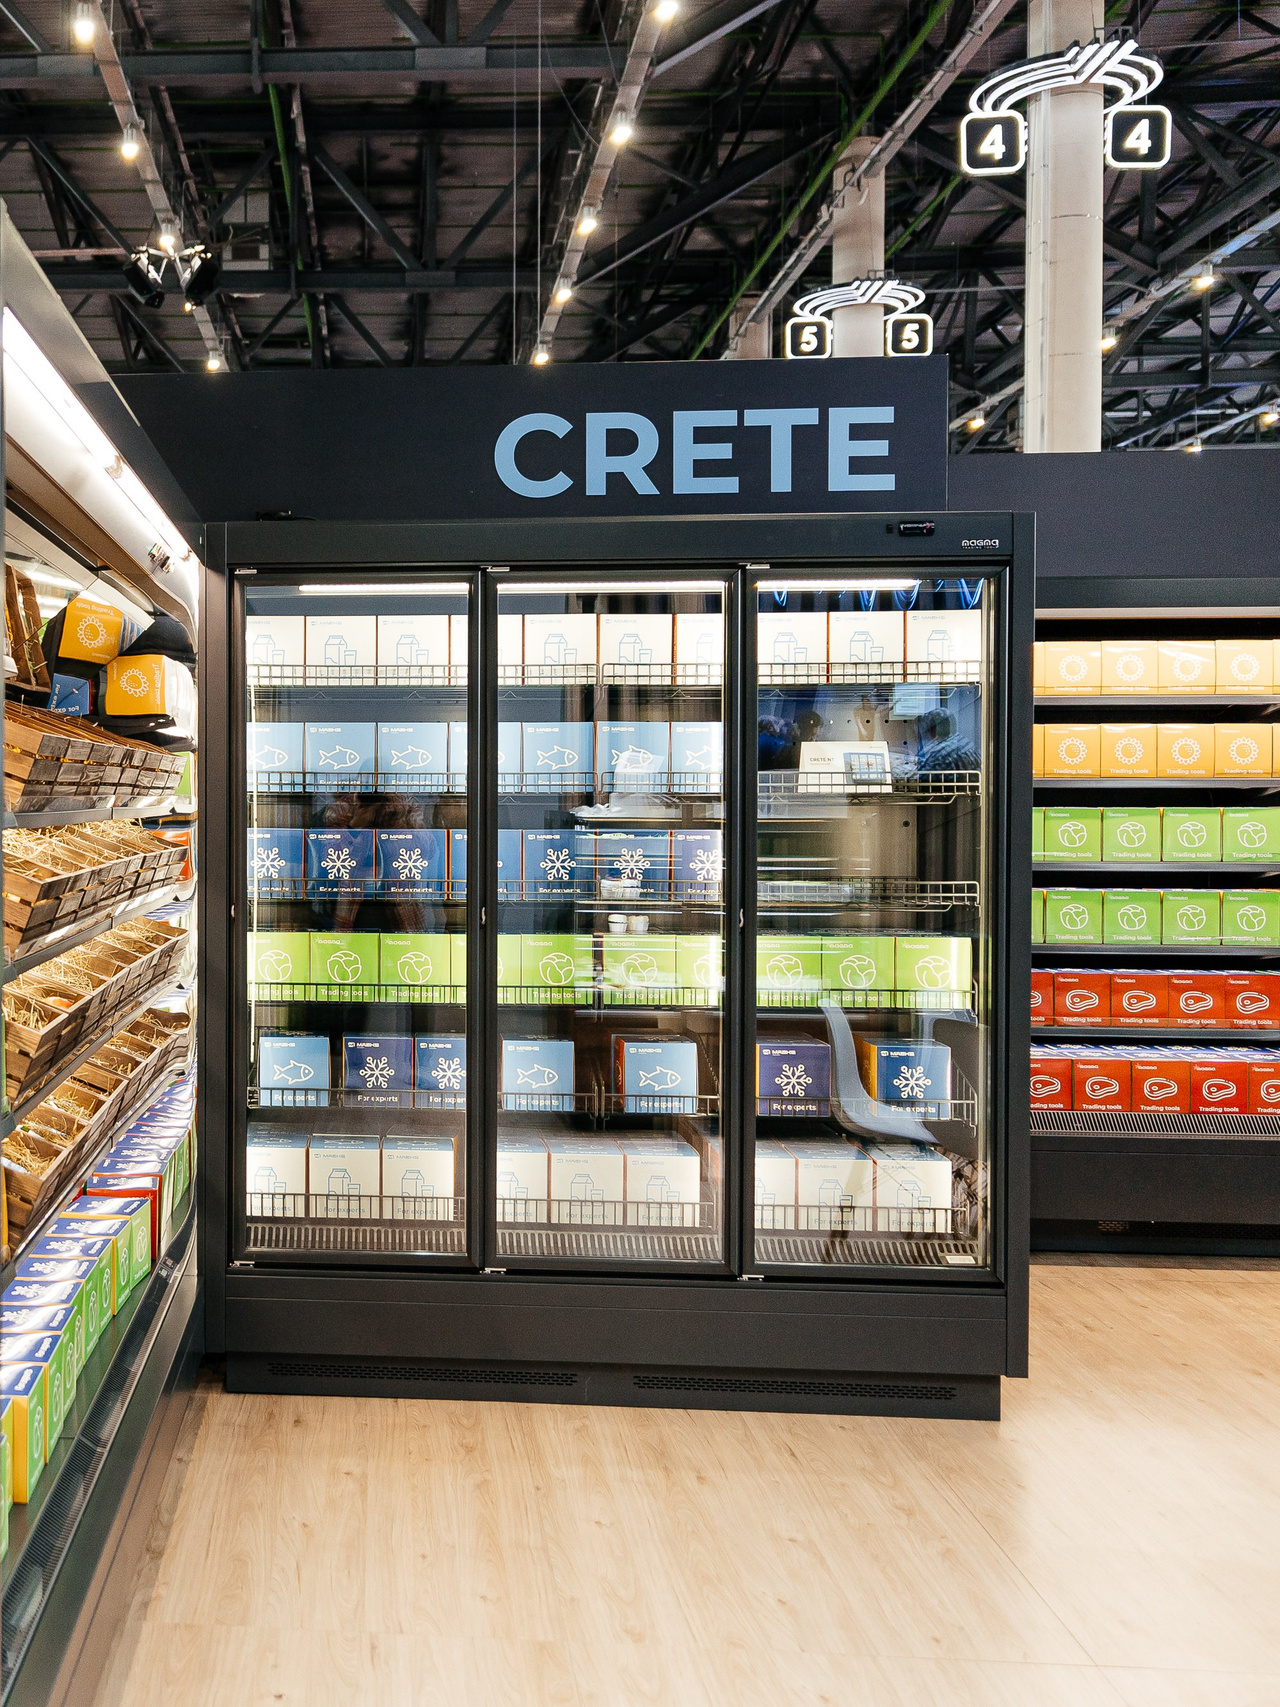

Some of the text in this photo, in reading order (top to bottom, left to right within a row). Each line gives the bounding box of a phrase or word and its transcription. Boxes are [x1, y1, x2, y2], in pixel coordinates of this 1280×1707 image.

[979, 123, 1006, 160] 4
[1124, 118, 1152, 155] 4
[800, 325, 820, 353] 5
[902, 322, 921, 350] 5
[494, 406, 897, 499] CRETE
[1257, 1107, 1280, 1115] Trading
